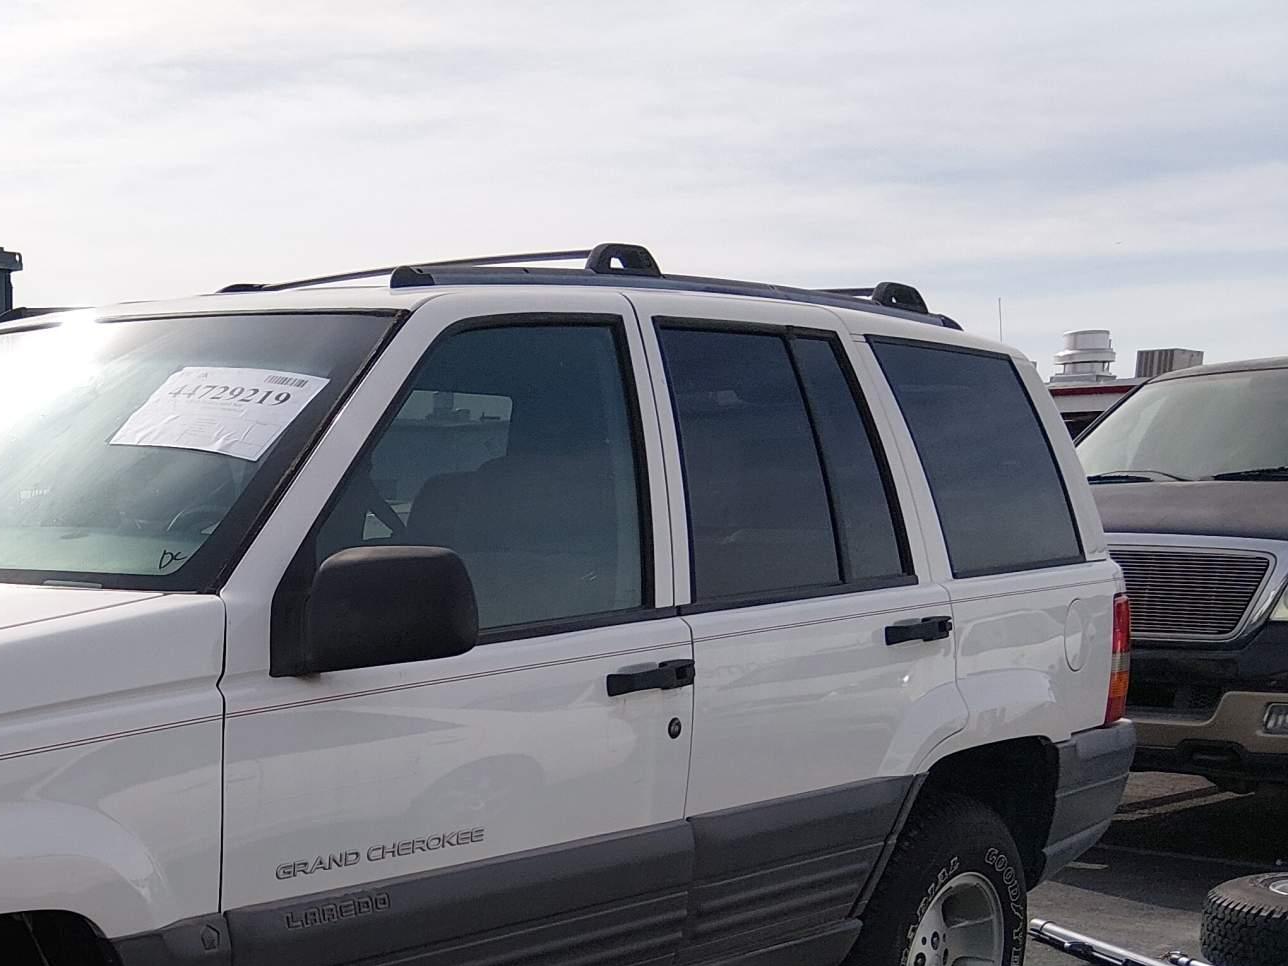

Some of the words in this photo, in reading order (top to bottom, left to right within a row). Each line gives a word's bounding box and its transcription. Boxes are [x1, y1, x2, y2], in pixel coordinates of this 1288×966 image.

[168, 384, 292, 406] 44729219
[275, 849, 361, 880] GRAND
[366, 828, 485, 862] CHEROKEE
[285, 891, 392, 929] LAREDO
